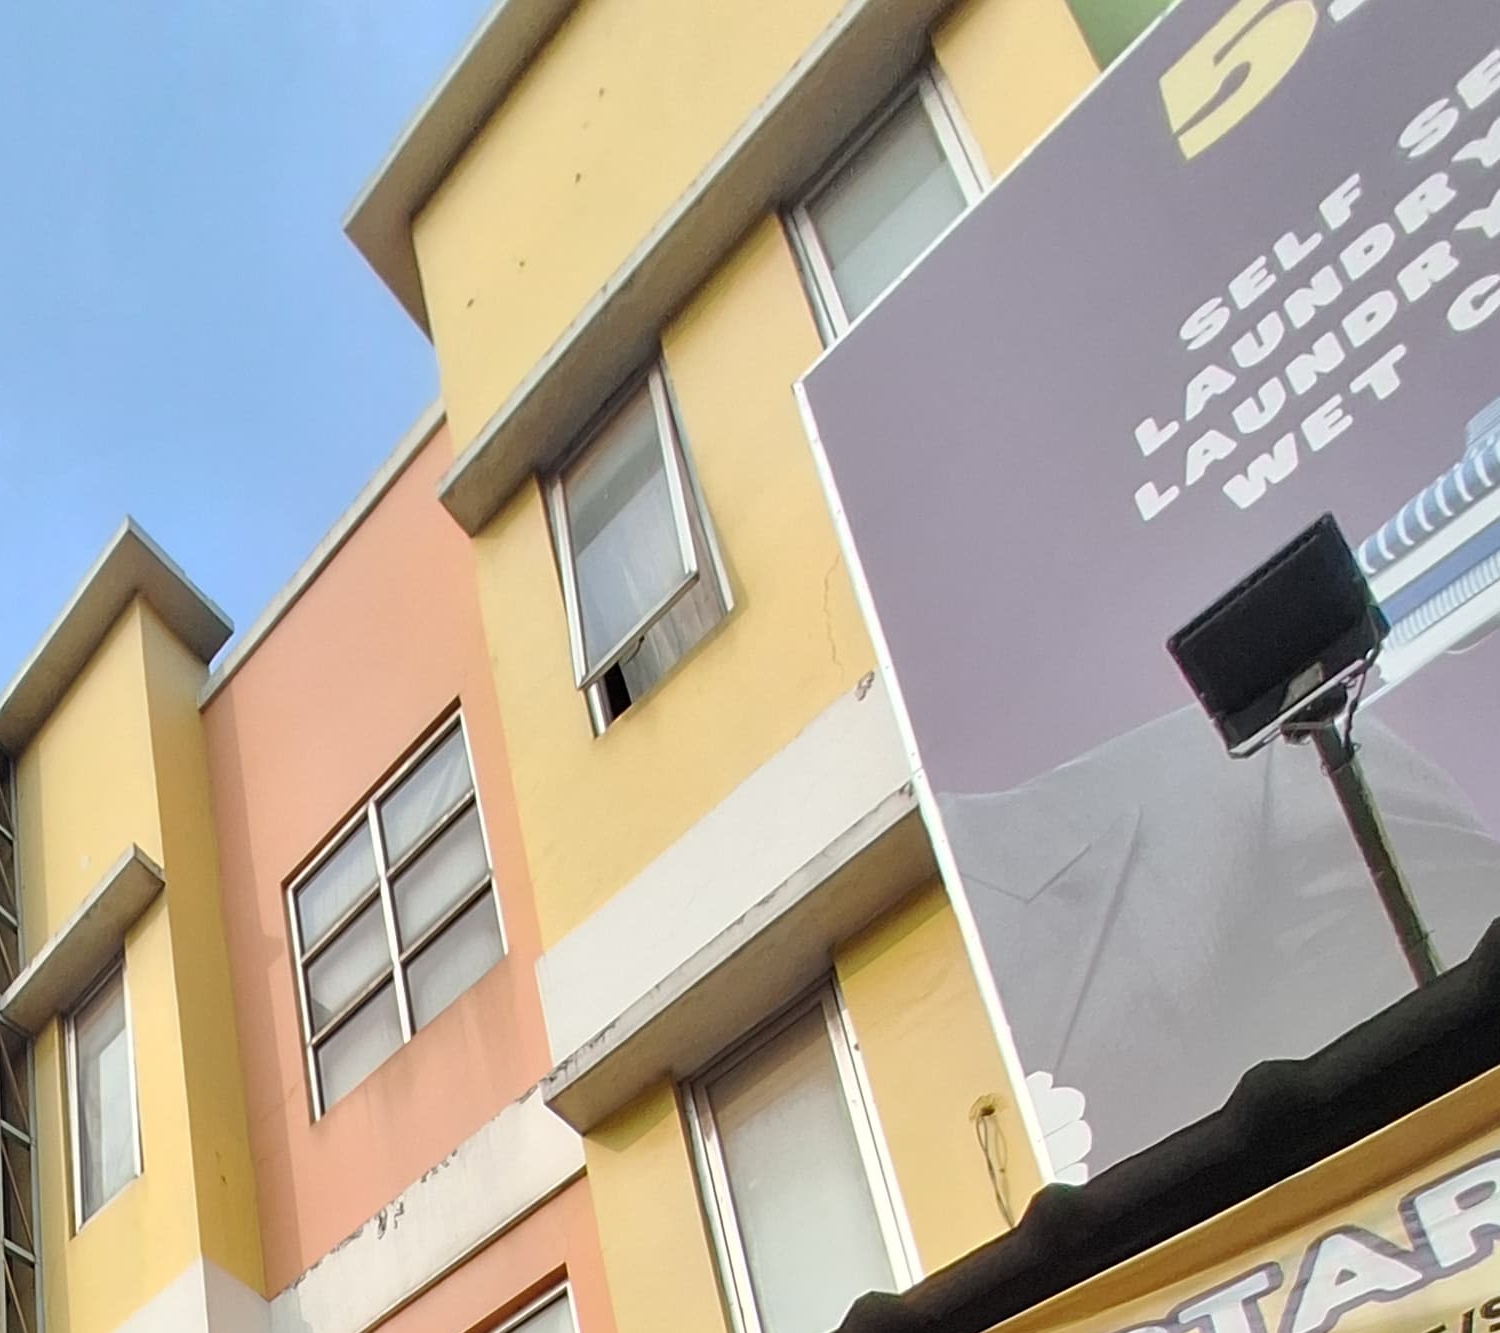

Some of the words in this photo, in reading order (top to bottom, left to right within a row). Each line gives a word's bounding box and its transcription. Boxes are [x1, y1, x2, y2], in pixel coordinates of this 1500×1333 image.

[1134, 116, 1500, 456] LAUNDRY
[1134, 188, 1500, 521] LAUNDRY
[1179, 173, 1362, 351] SELF
[1222, 343, 1407, 509] WET
